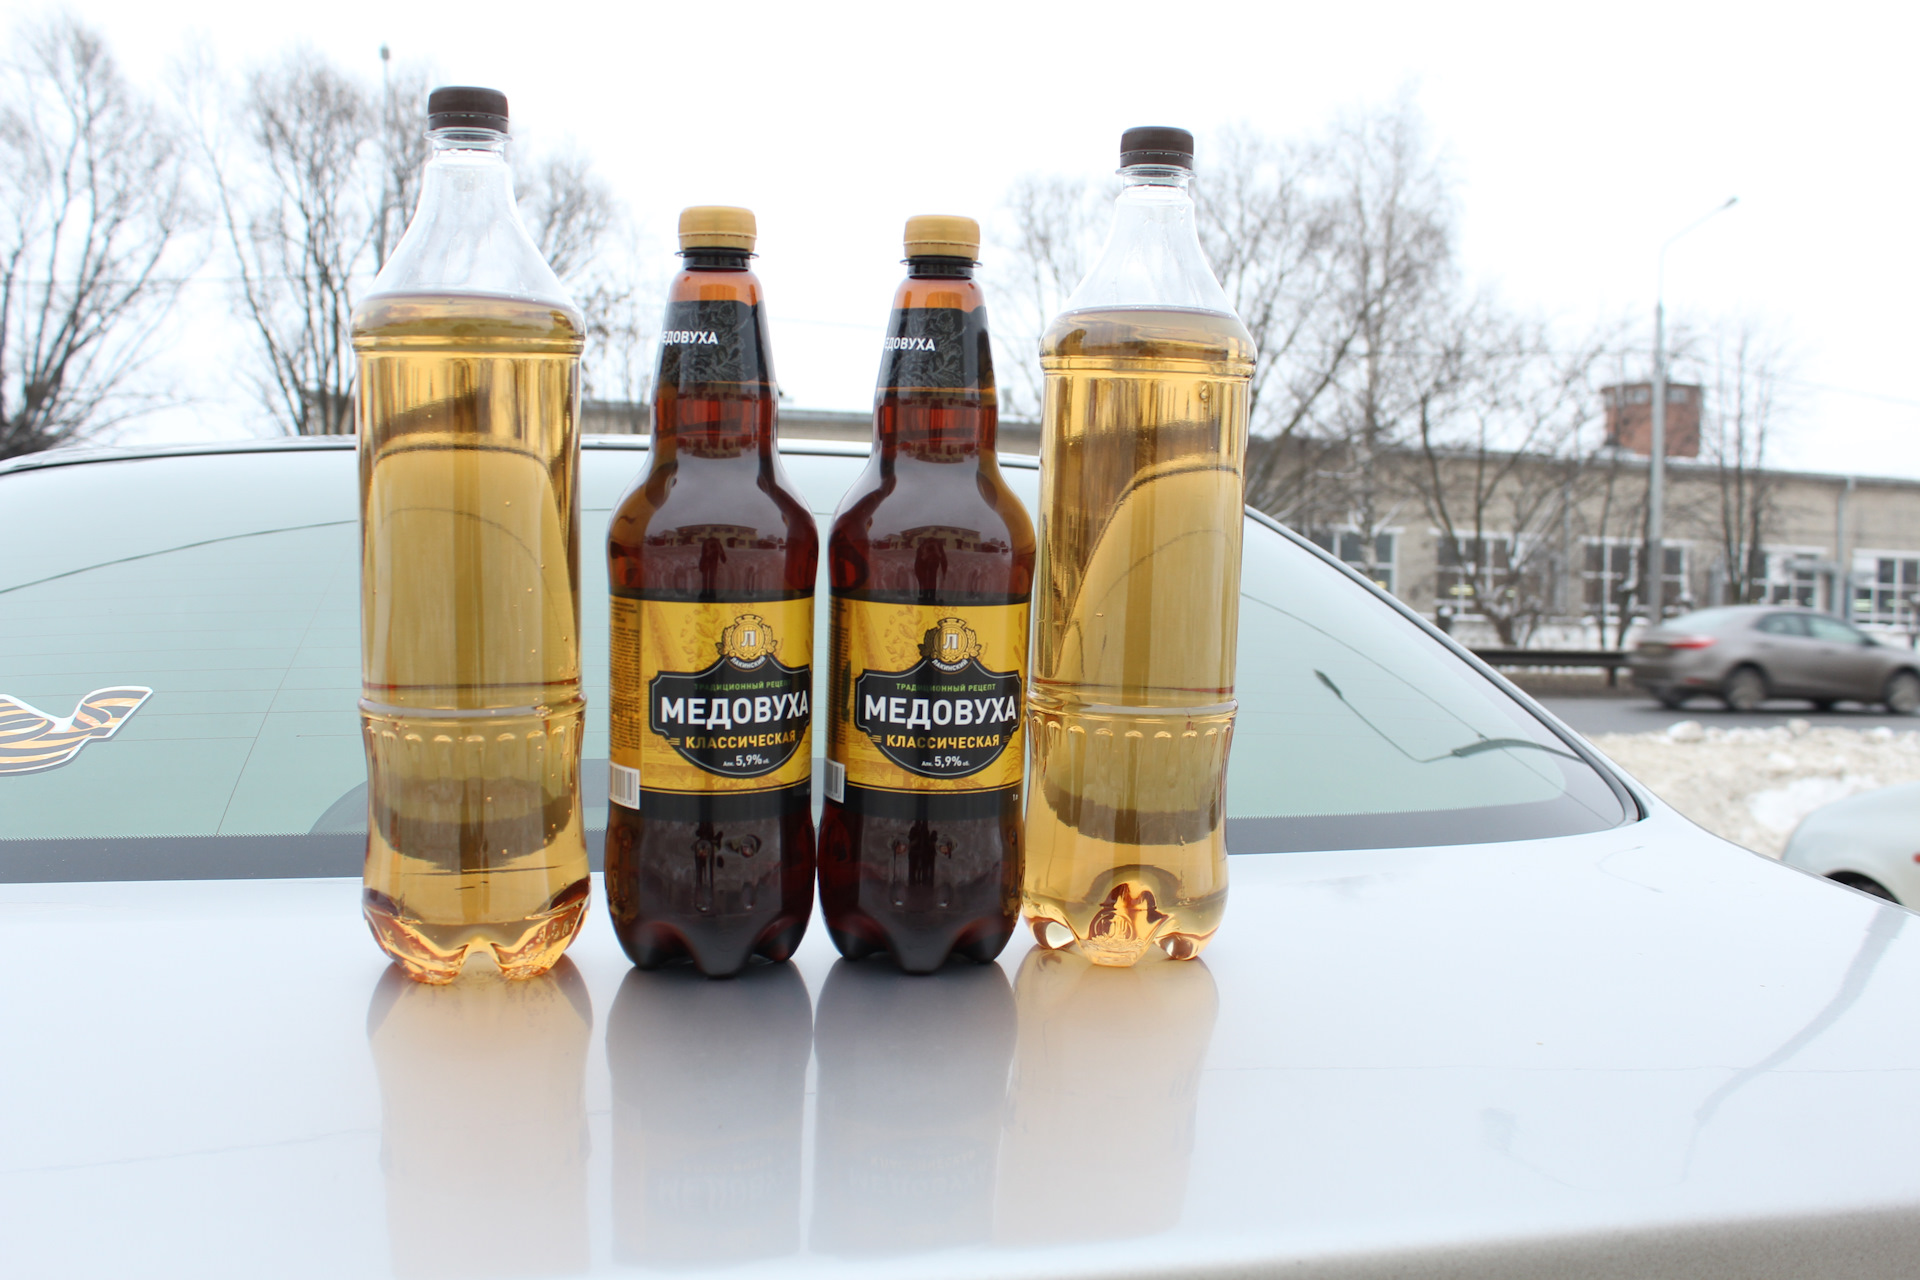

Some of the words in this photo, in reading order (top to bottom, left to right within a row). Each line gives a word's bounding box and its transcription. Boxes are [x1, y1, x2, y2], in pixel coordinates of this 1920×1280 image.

[661, 330, 719, 346] ЕДОВУХА
[885, 337, 936, 352] ЕДОВУХА
[741, 630, 755, 647] Л
[943, 633, 958, 650] Л
[931, 658, 968, 672] ЛАКИНСКИЙ
[968, 683, 997, 692] РЕЦЕПТ
[660, 690, 809, 730] МЕДОВУХА
[864, 694, 1016, 730] МЕДОВУХА
[685, 730, 796, 749] КЛАССИЧЕСКАЯ
[886, 734, 1000, 750] КЛАССИЧЕСКАЯ
[735, 753, 763, 767] 5,9%
[934, 755, 962, 768] 5,9%
